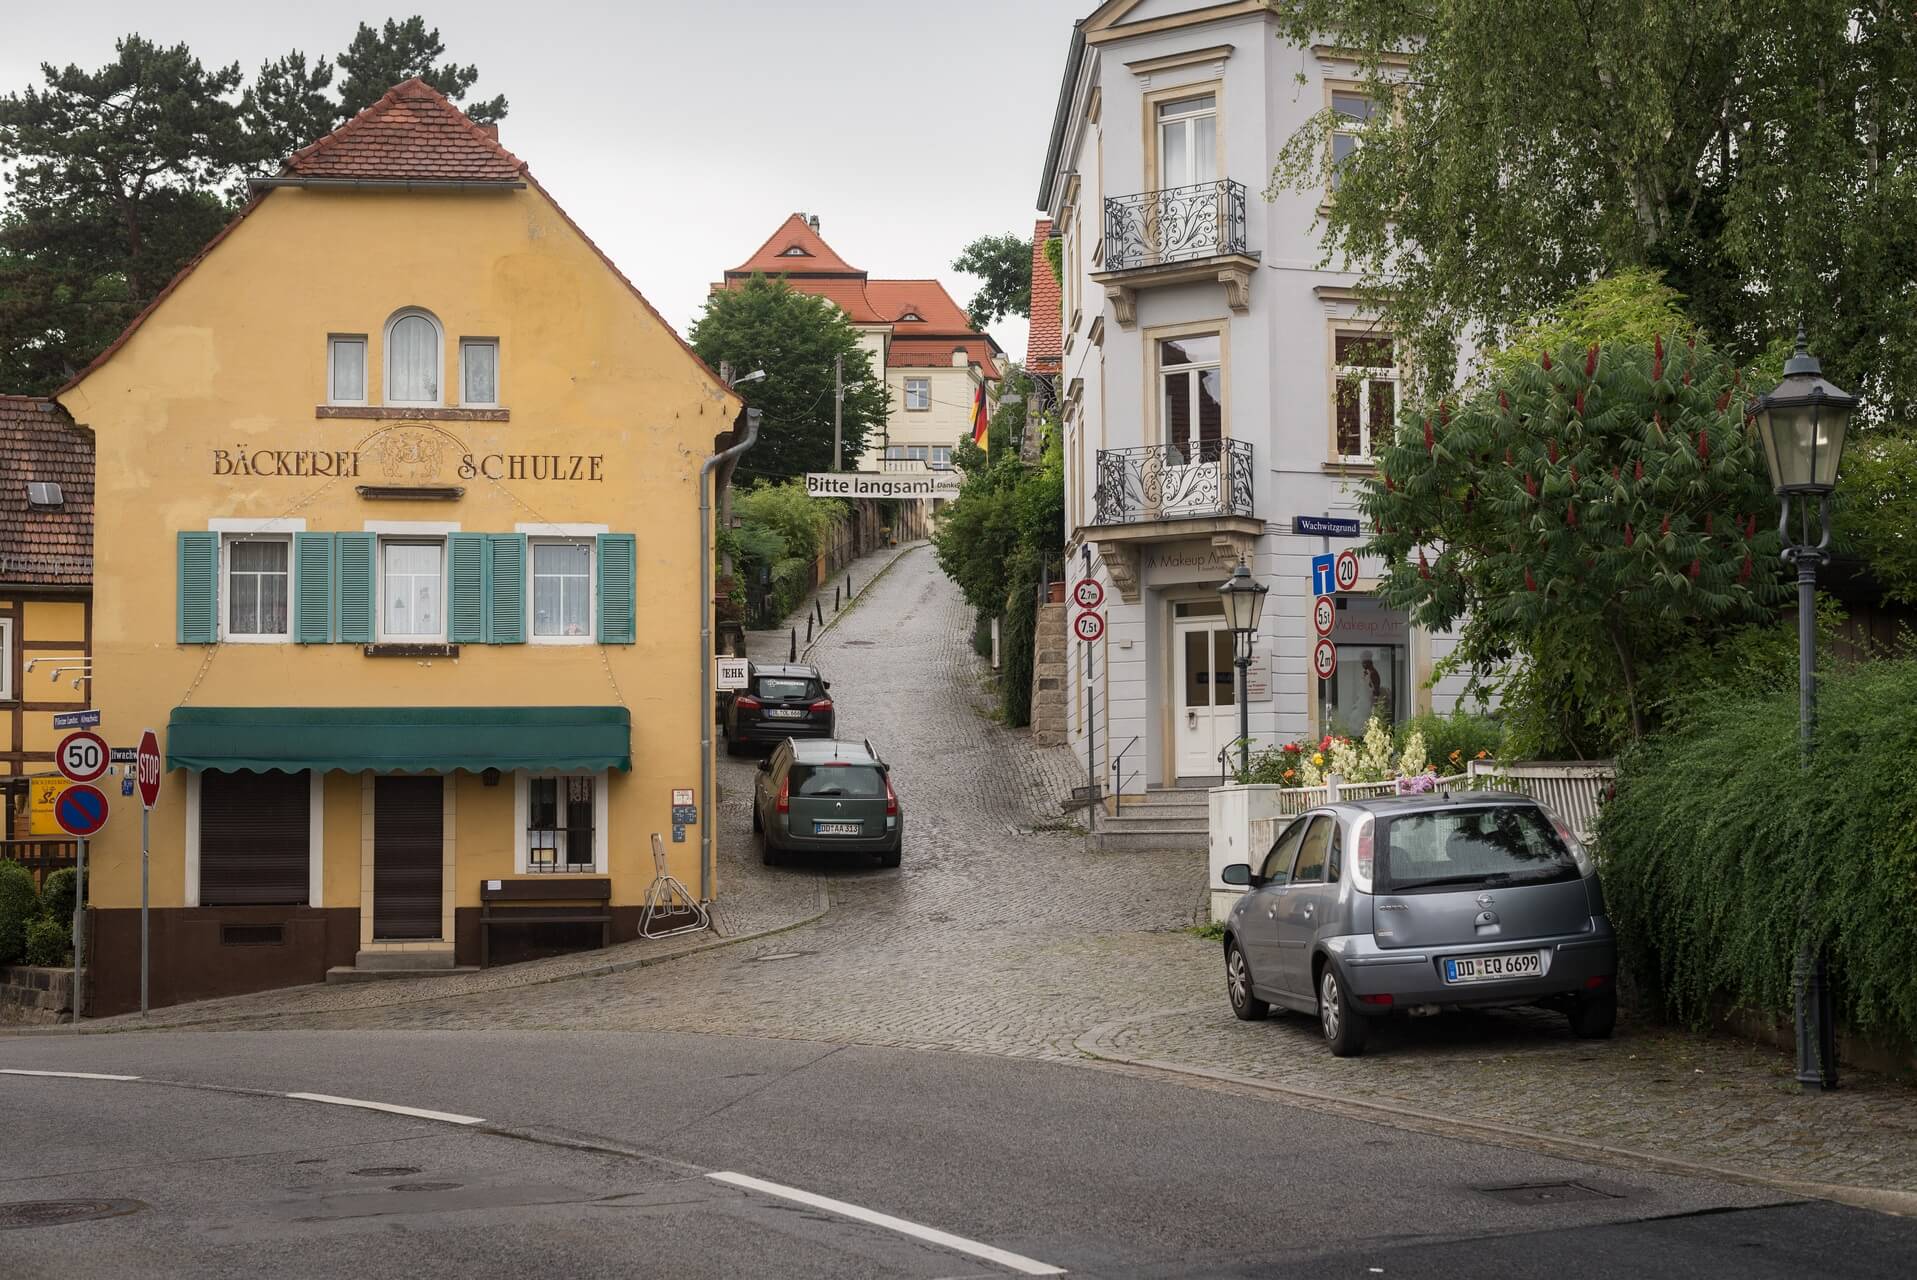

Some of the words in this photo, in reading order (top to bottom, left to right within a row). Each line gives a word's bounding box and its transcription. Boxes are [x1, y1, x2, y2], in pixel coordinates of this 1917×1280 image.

[213, 443, 361, 477] BÄCKEREI
[458, 454, 603, 482] SCHULZE
[808, 476, 849, 493] Bitte
[854, 477, 934, 496] langsam!
[1302, 520, 1357, 533] Wachwitzgrund
[1160, 552, 1204, 571] Makeup
[1341, 561, 1353, 580] 20
[1081, 620, 1097, 633] 7,5t
[69, 745, 99, 769] 50
[140, 752, 160, 785] STOP
[821, 824, 830, 832] DD
[1456, 961, 1475, 976] DD
[1484, 958, 1502, 974] EQ
[1506, 955, 1538, 973] 6699
